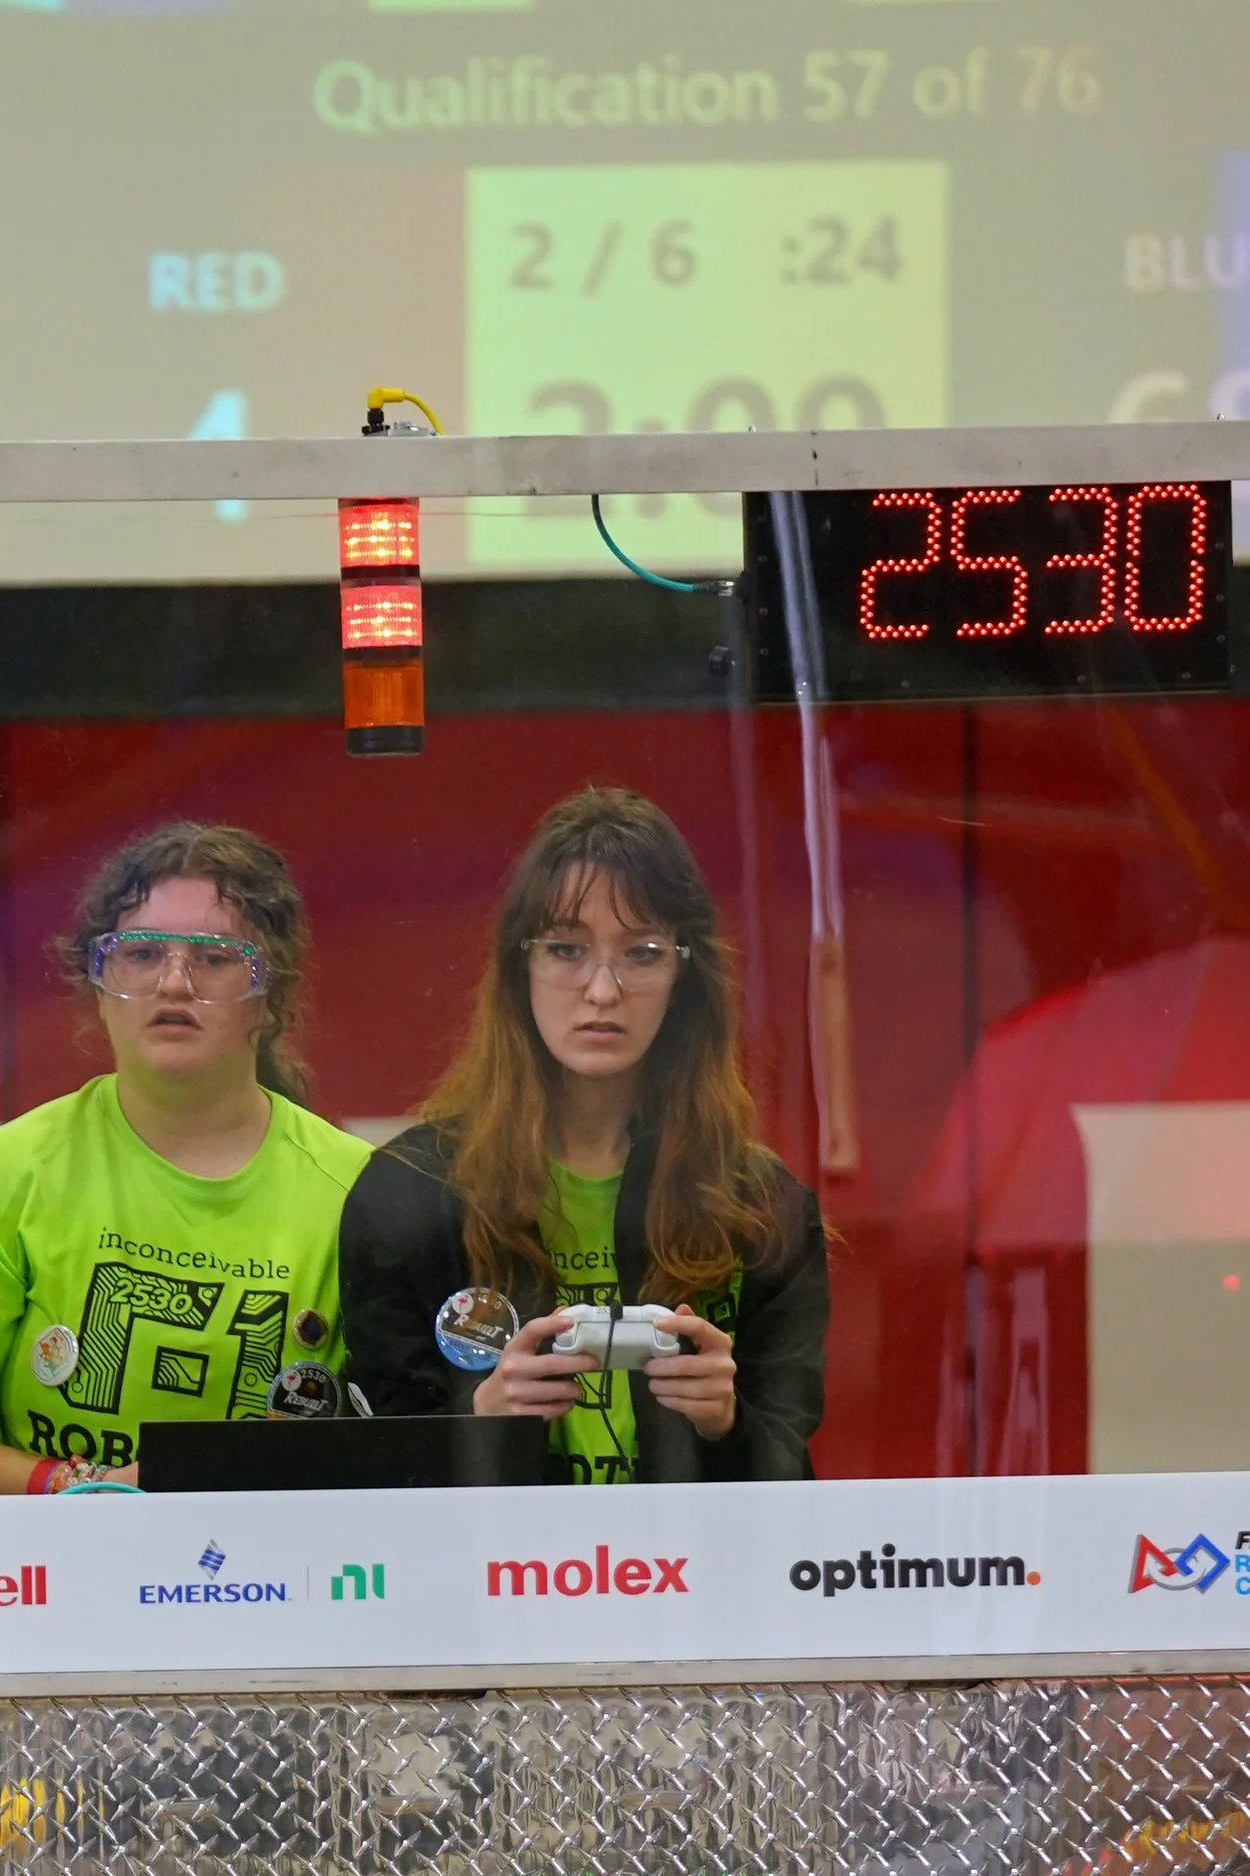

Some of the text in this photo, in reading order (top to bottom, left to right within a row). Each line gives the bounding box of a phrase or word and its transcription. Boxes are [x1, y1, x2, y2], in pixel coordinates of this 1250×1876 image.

[313, 44, 1102, 134] Qualification 57 of 76
[509, 221, 554, 291] 2
[651, 217, 698, 287] 6
[781, 214, 904, 285] :24
[149, 250, 287, 311] RED
[859, 484, 1206, 640] 2530
[99, 1227, 290, 1280] inconceivable
[109, 1278, 193, 1315] 2530
[300, 1369, 327, 1383] 2530
[27, 1409, 140, 1467] ROB
[139, 1583, 285, 1604] EMERSON
[487, 1545, 689, 1596] molex
